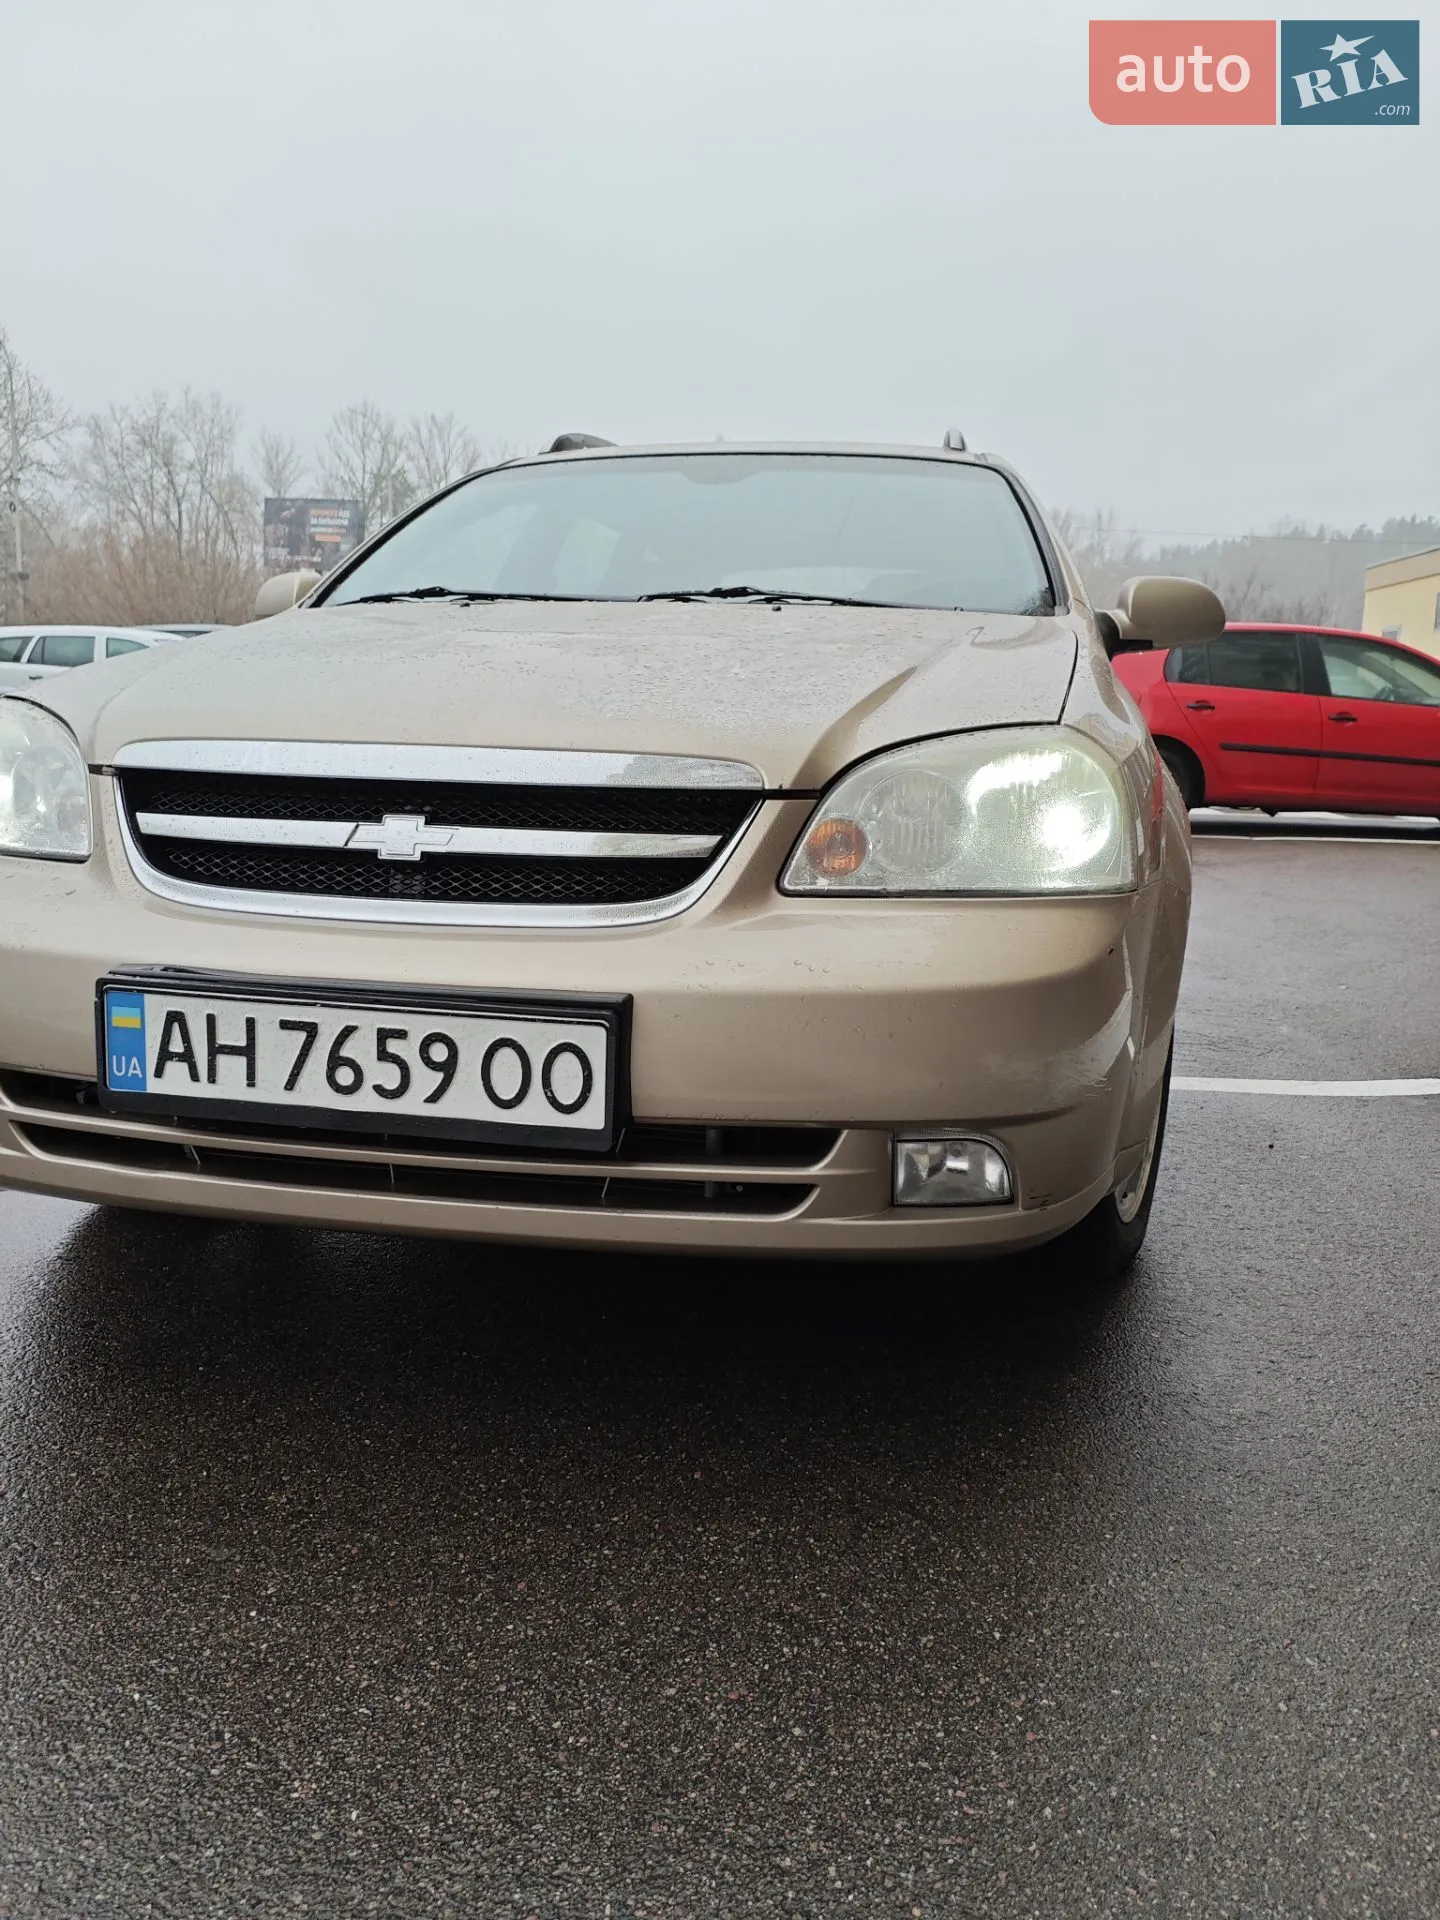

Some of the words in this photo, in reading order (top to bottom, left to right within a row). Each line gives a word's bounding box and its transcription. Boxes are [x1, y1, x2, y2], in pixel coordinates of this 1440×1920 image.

[112, 1055, 143, 1079] UA
[153, 1009, 257, 1088] AH
[279, 1019, 459, 1104] 7659
